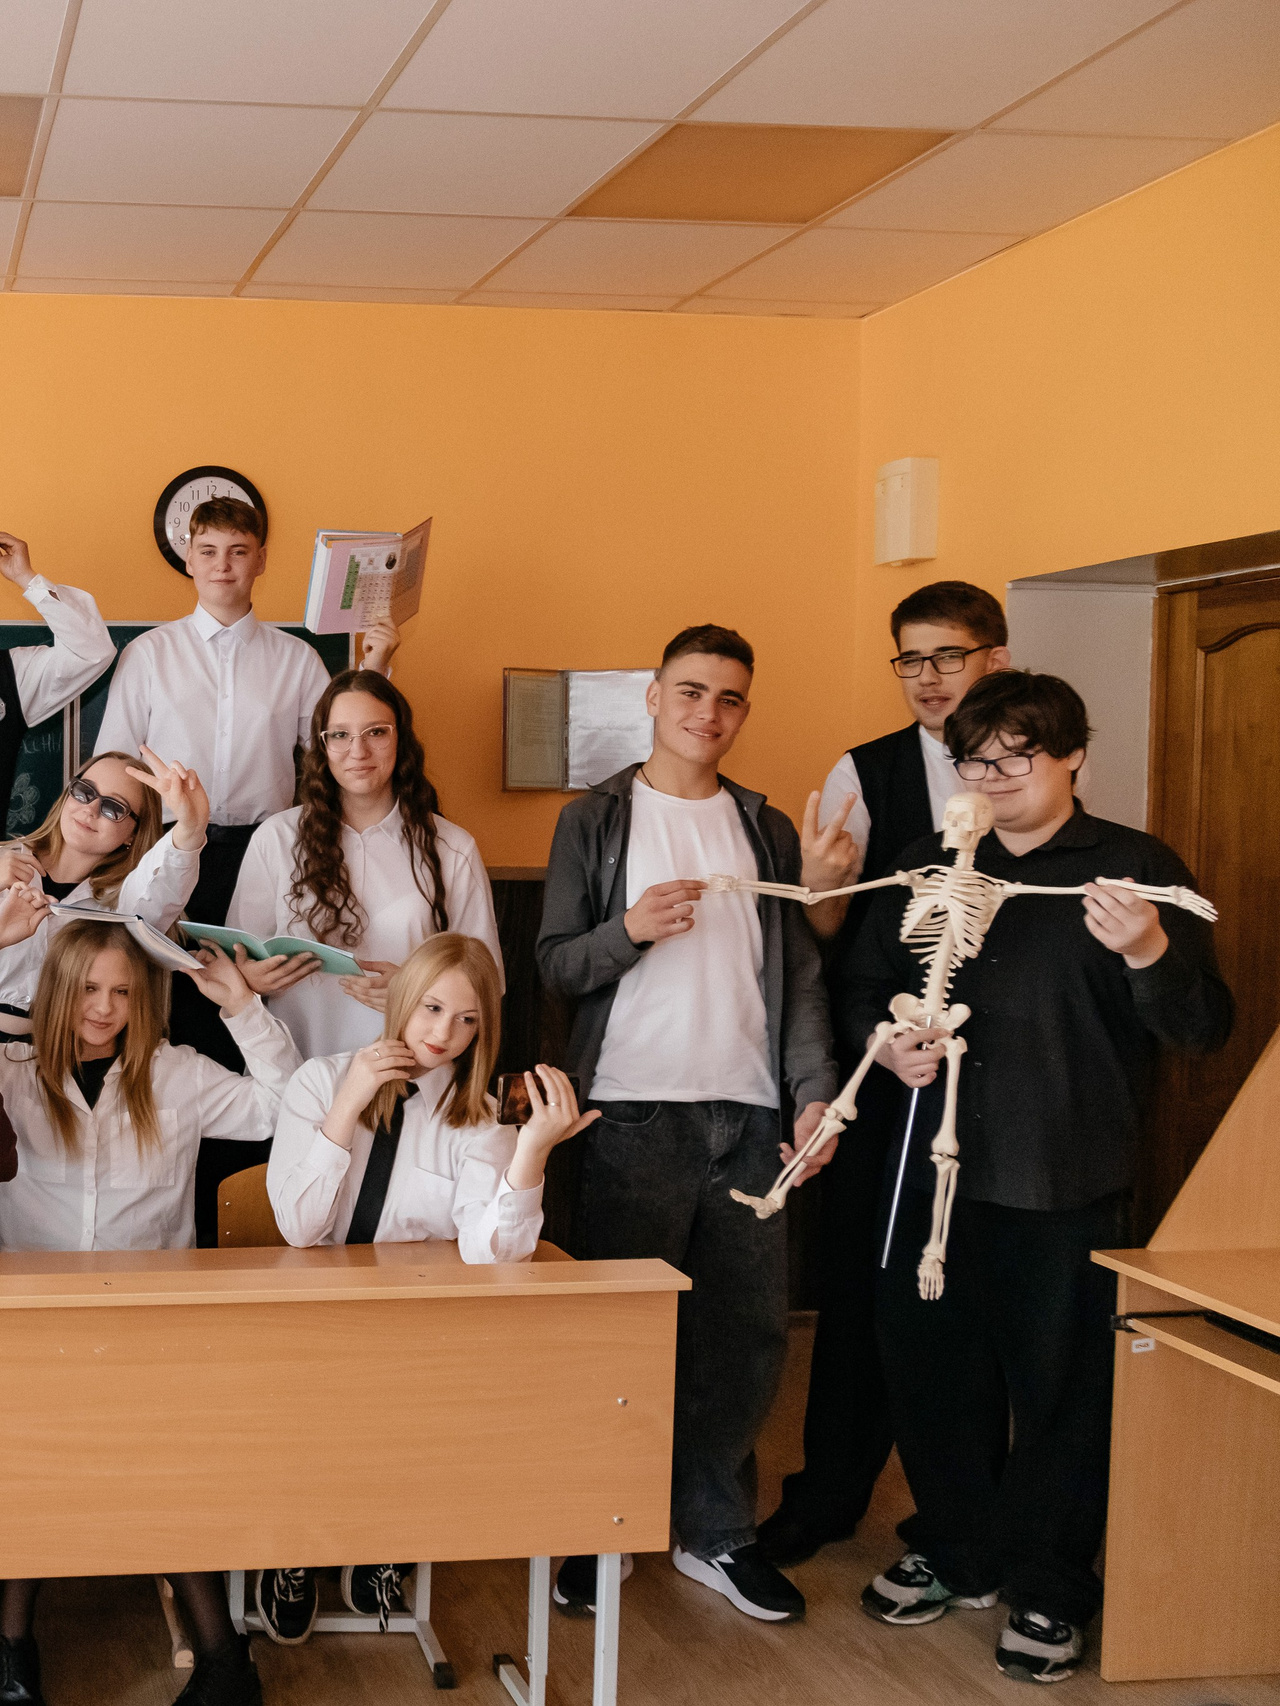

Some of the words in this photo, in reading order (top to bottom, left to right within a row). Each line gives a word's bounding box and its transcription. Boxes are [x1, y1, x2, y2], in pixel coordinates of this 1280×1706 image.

[191, 490, 200, 500] 11
[206, 485, 217, 495] 12
[179, 502, 190, 512] 10
[173, 517, 181, 528] 9
[179, 534, 186, 545] 8
